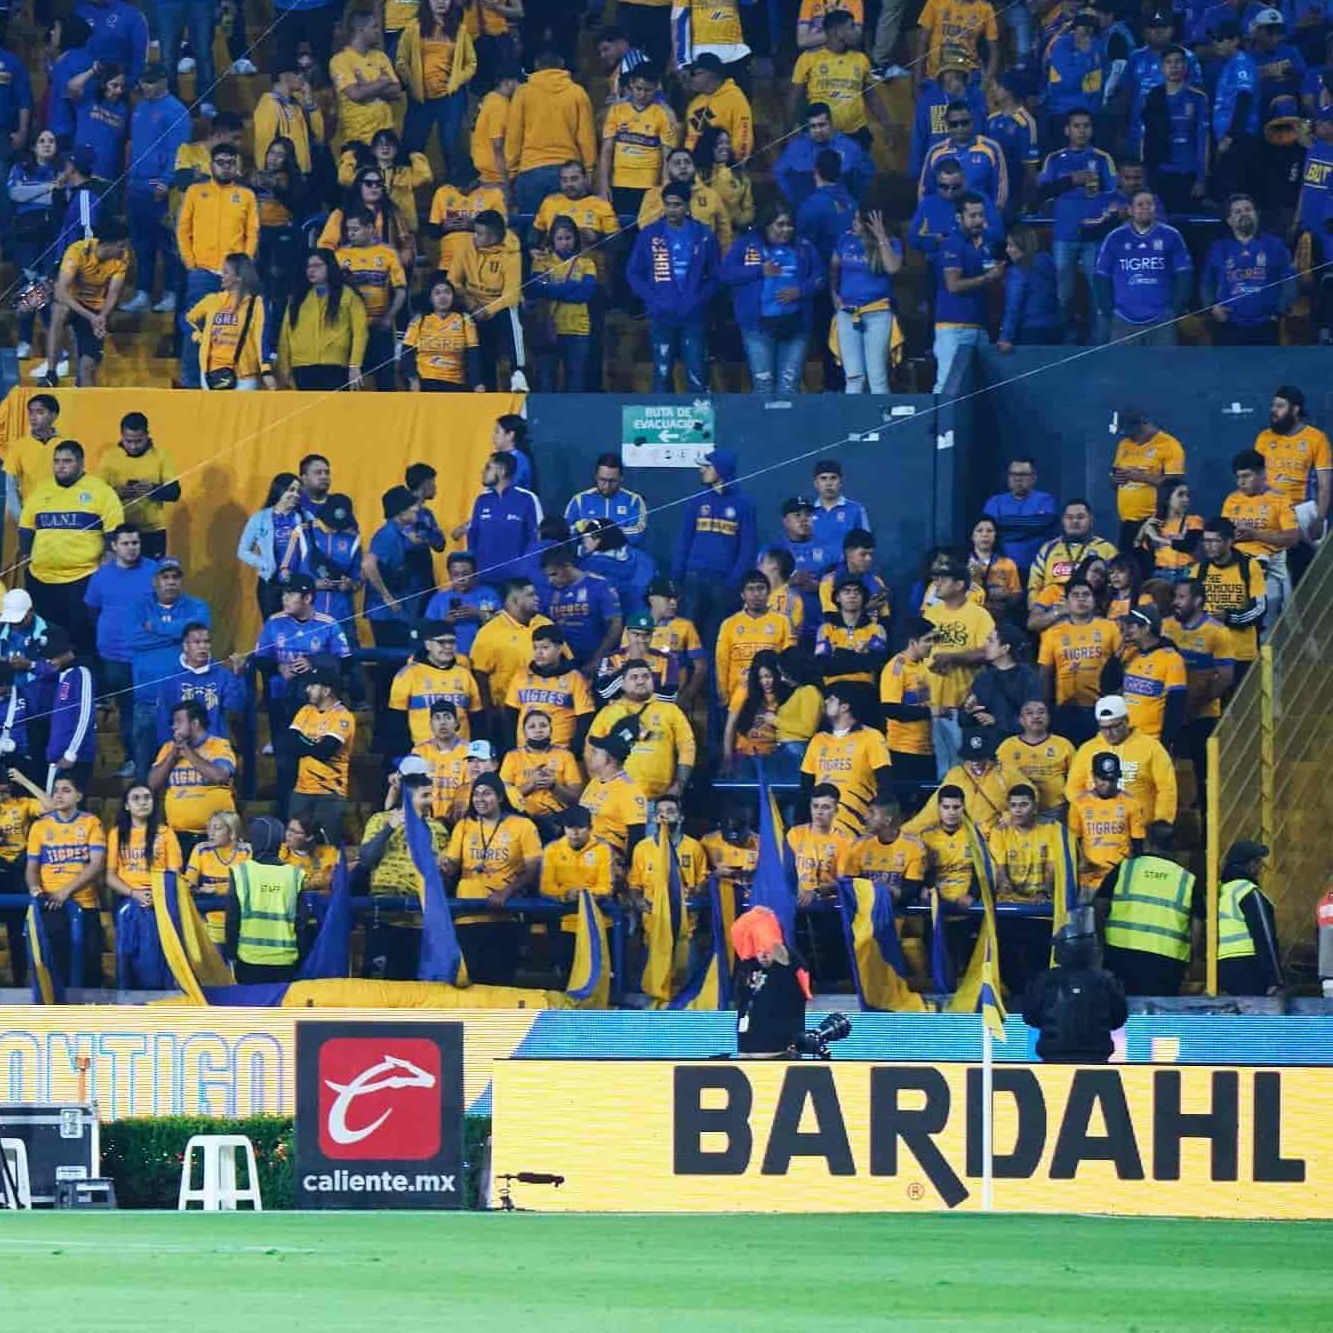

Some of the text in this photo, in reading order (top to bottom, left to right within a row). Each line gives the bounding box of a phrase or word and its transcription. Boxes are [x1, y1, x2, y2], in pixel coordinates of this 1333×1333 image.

[1119, 257, 1165, 271] TIGRES
[645, 407, 693, 417] RUTA DE
[520, 690, 566, 706] TIGRES
[170, 769, 202, 785] TIGR
[1086, 821, 1126, 835] TIGRES
[46, 847, 89, 864] TIGRES
[469, 849, 509, 860] TIGRES
[1144, 871, 1168, 880] STAFF
[674, 1065, 1306, 1208] BARDAHL
[302, 1169, 457, 1193] caliente.mx
